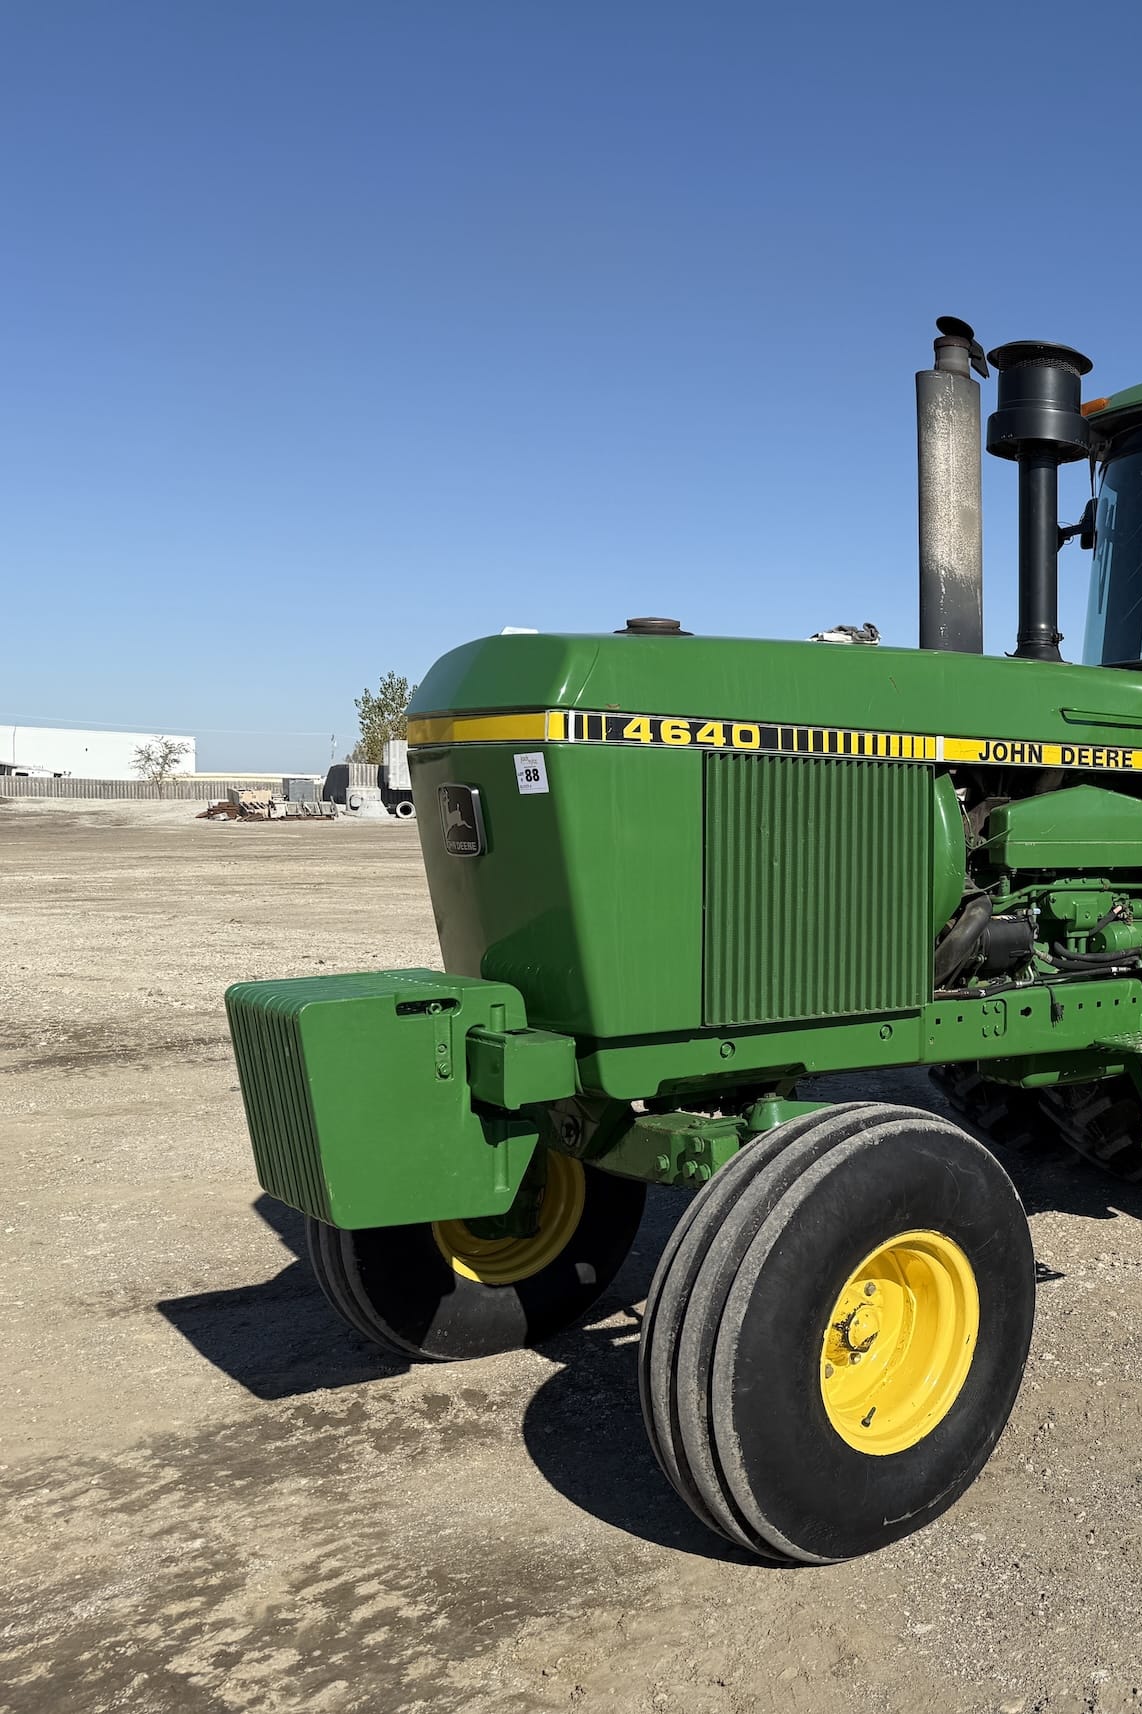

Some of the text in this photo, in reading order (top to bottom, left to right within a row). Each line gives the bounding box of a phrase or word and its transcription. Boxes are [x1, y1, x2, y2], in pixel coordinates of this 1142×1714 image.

[623, 717, 761, 749] 4640
[978, 741, 1133, 769] JOHN DEERE
[525, 768, 540, 782] 88
